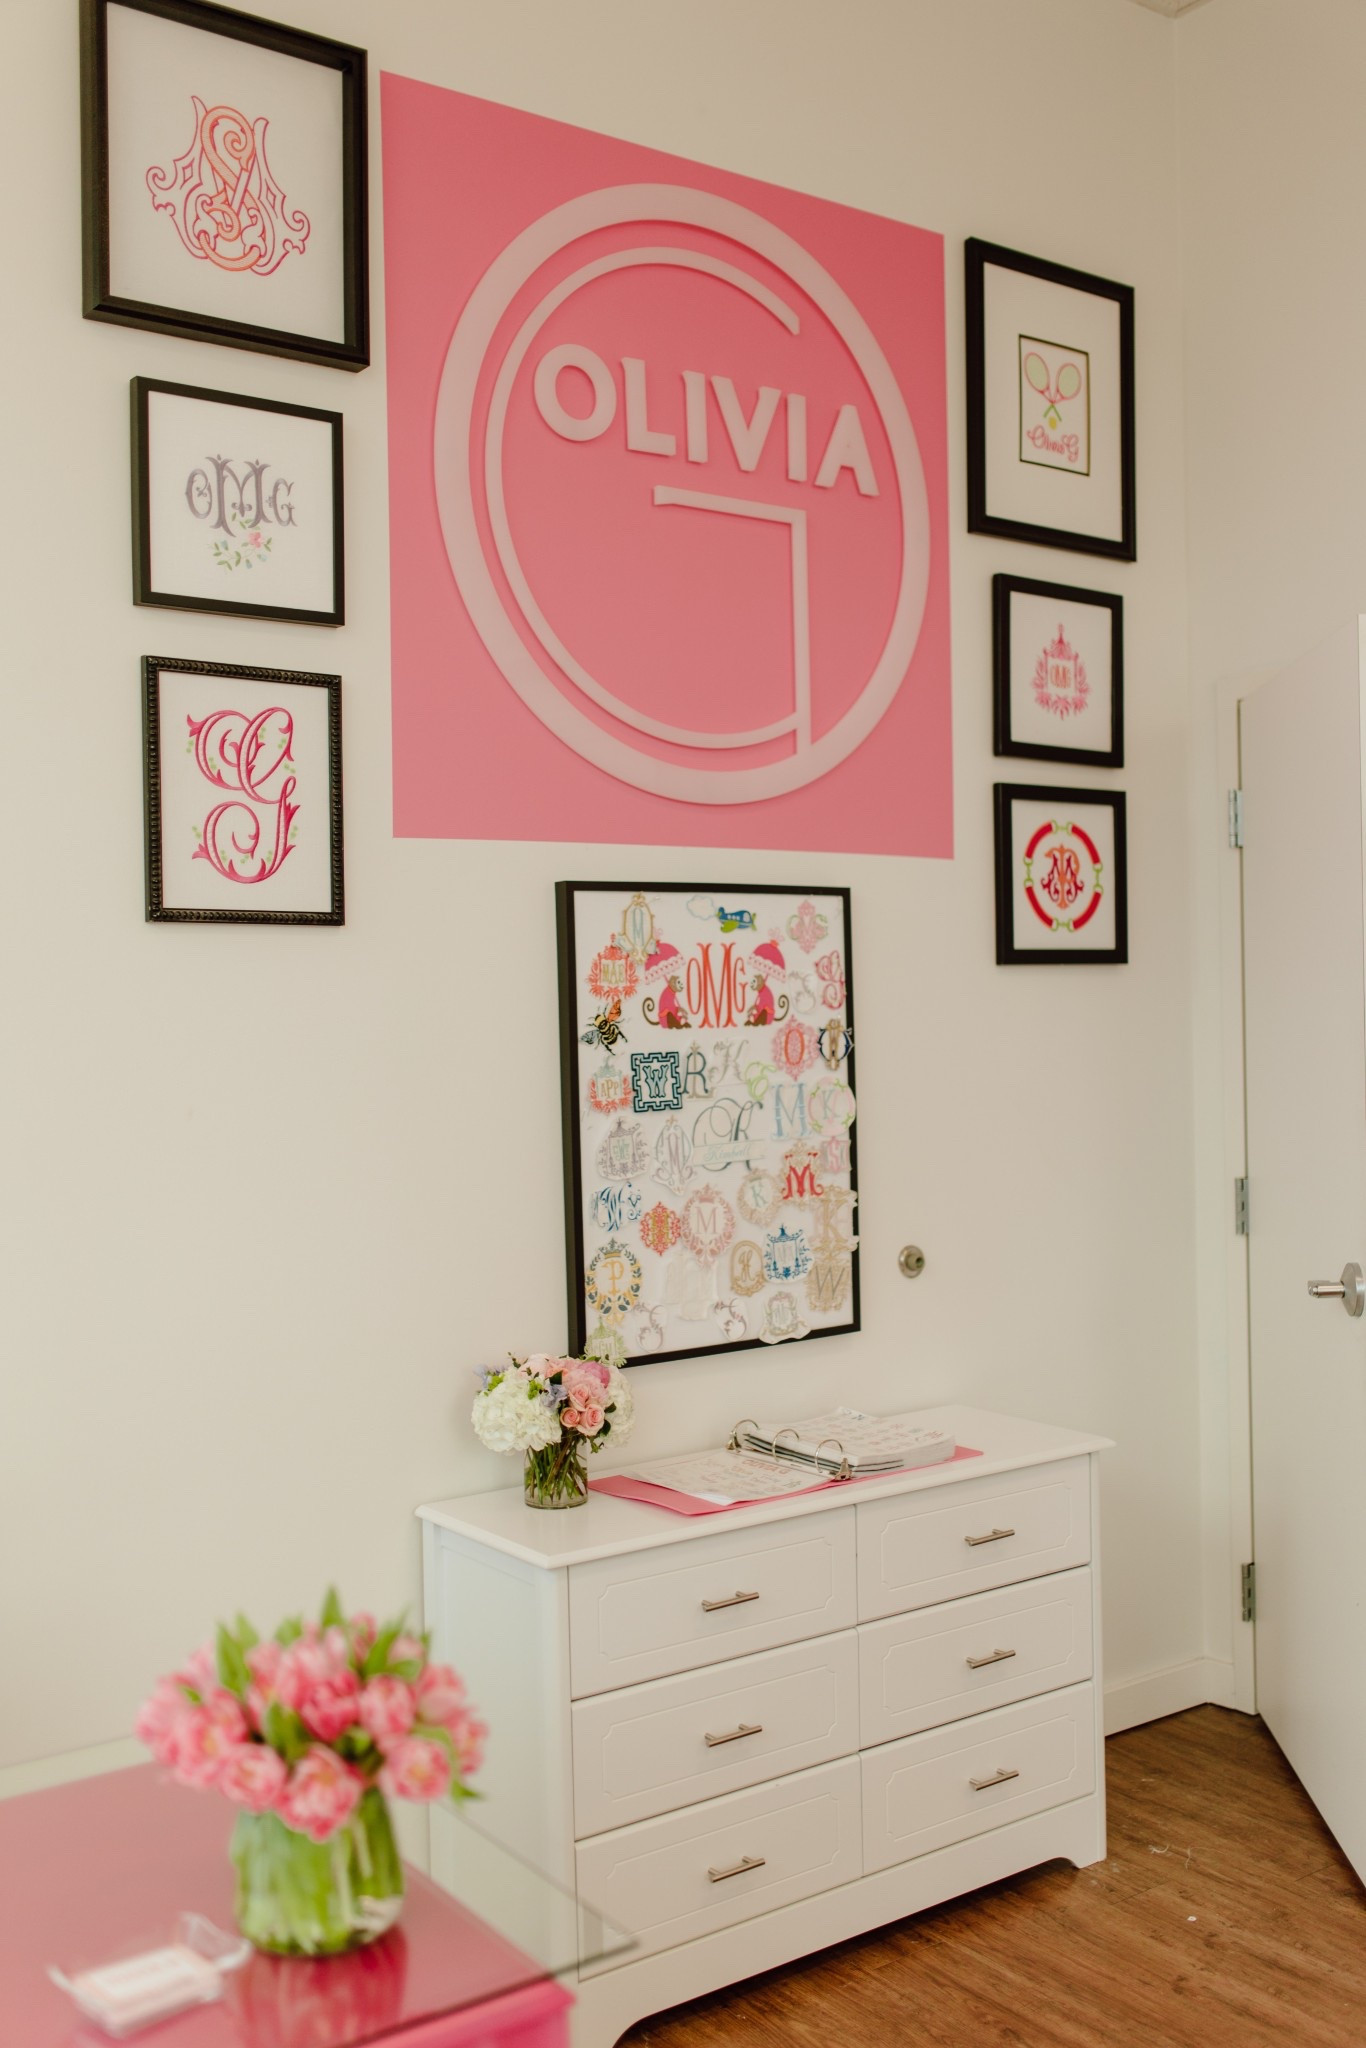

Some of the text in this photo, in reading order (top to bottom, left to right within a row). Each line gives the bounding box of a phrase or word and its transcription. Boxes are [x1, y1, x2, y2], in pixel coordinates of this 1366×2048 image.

[533, 343, 880, 497] OLIVIA
[185, 454, 298, 538] OMG
[686, 942, 748, 1029] OMG
[642, 1064, 669, 1099] W
[771, 1082, 812, 1139] M
[782, 1151, 825, 1200] M
[695, 1206, 719, 1235] M
[601, 1260, 625, 1297] P
[814, 1265, 846, 1301] W
